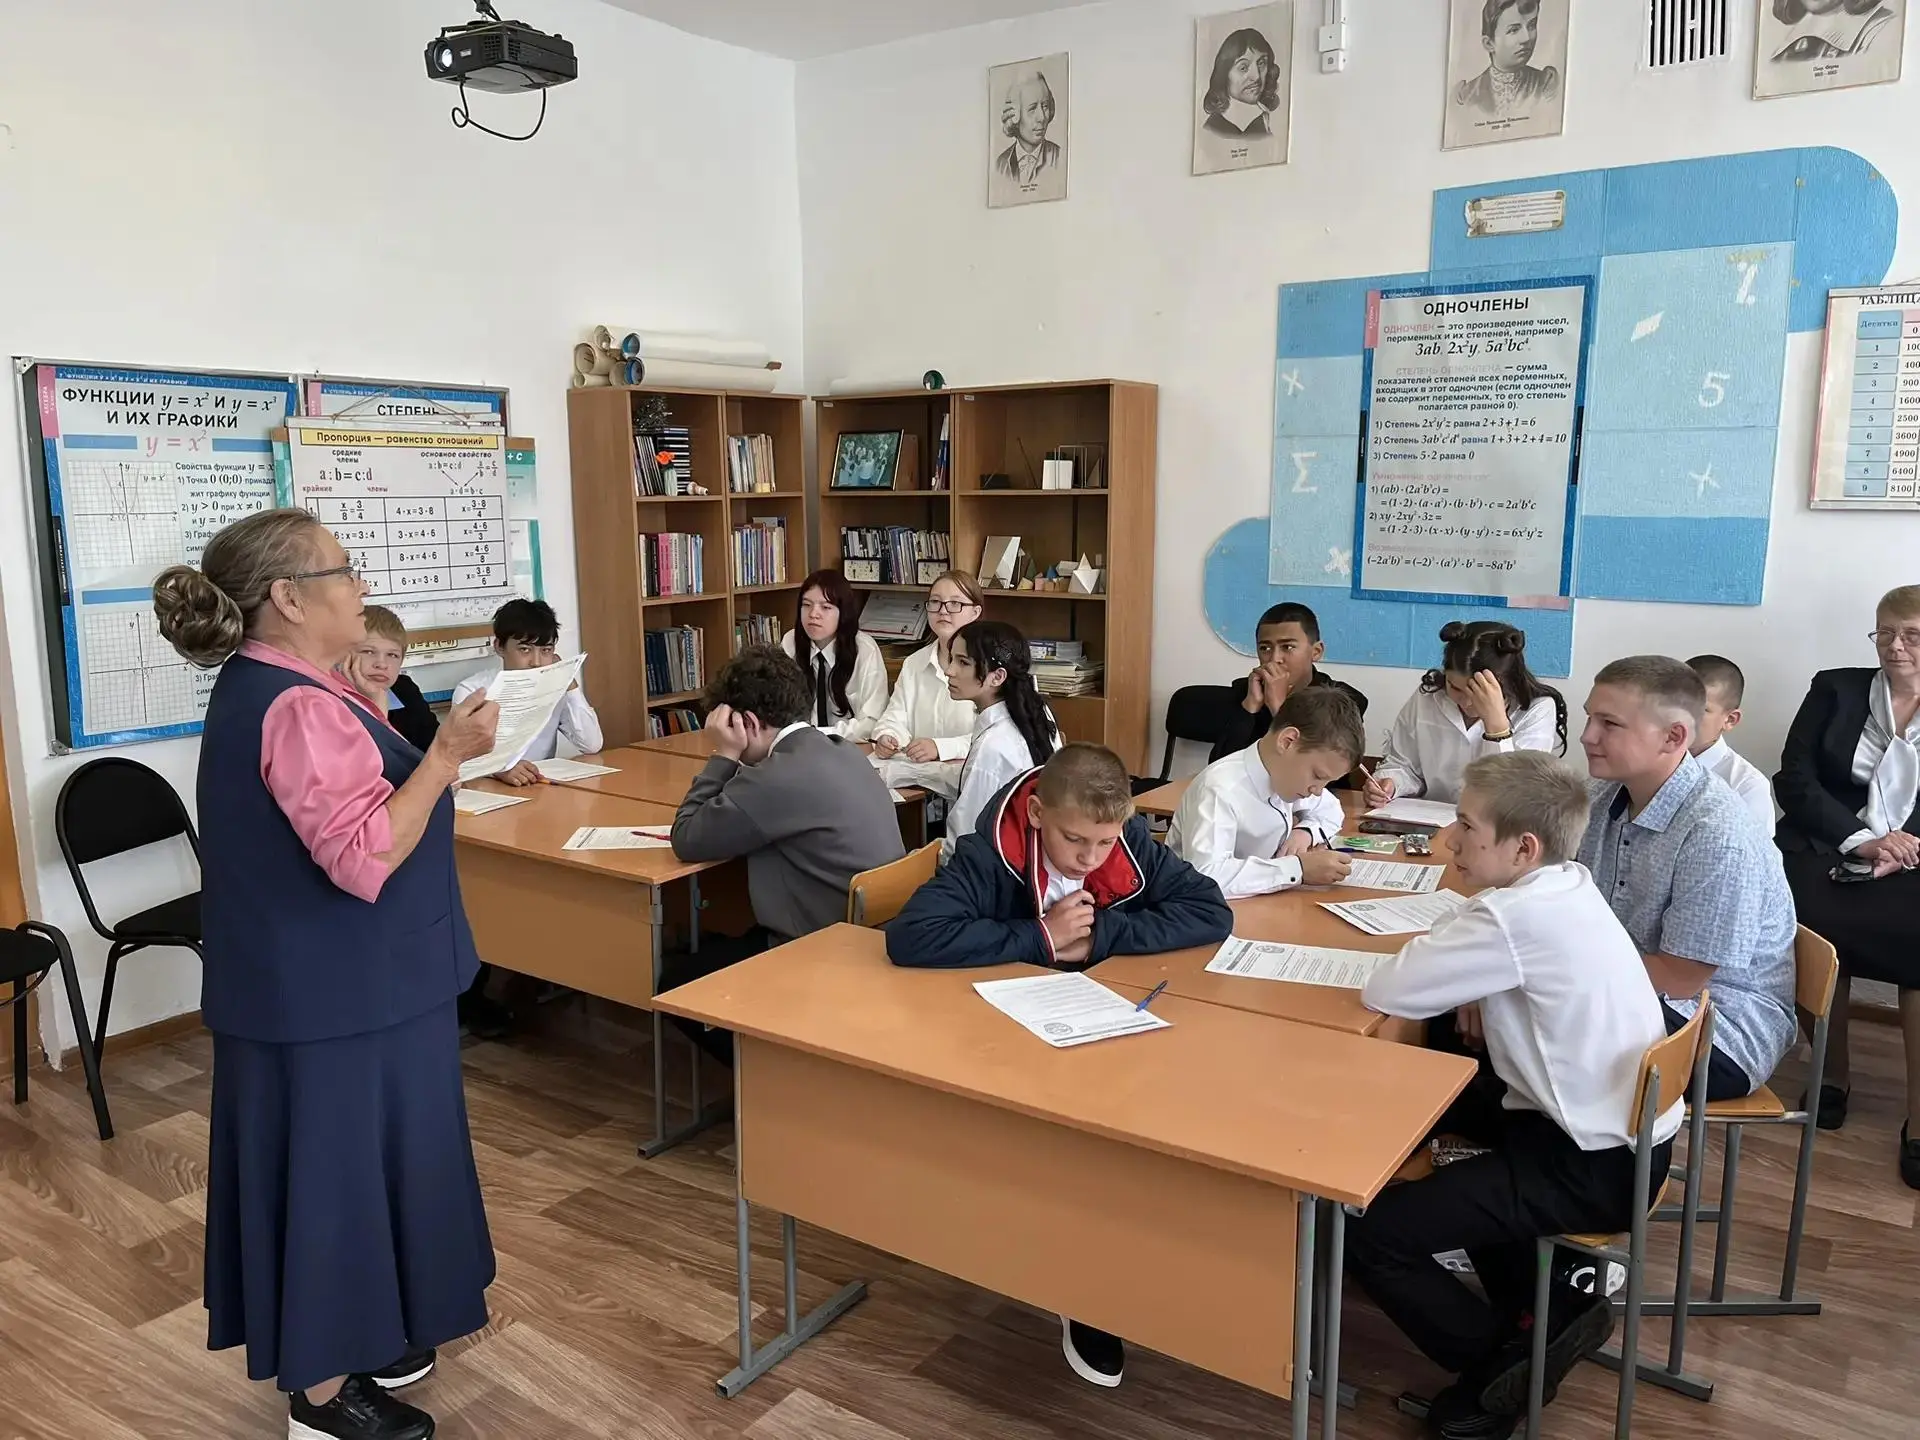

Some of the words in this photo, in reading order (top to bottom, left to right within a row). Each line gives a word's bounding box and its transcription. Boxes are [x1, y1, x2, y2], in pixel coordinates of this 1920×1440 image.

[1423, 296, 1529, 317] ОДНОЧЛЕНЫ
[1448, 322, 1464, 331] это
[1466, 319, 1534, 331] произведение
[1536, 317, 1569, 326] чисел,
[1860, 320, 1898, 329] Десятки
[1912, 326, 1918, 334] 0
[1386, 332, 1442, 343] переменных
[1466, 329, 1512, 339] степеней,
[1514, 327, 1564, 338] например
[1874, 344, 1879, 352] 1
[1516, 364, 1548, 373] сумма
[1904, 361, 1920, 369] 400
[1377, 376, 1432, 385] показателей
[1434, 374, 1476, 384] степеней
[1478, 374, 1500, 382] всех
[1502, 372, 1567, 382] переменных,
[1871, 379, 1877, 387] 3
[1902, 379, 1919, 387] 900
[1375, 386, 1418, 395] входящих
[1449, 384, 1493, 394] одночлен
[1495, 383, 1521, 392] (если
[1523, 382, 1571, 391] одночлен
[1698, 371, 1731, 408] 5
[62, 388, 155, 407] ФУНКЦИИ
[215, 396, 225, 409] И
[1388, 395, 1430, 404] содержит
[1432, 393, 1493, 403] переменных,
[1526, 392, 1567, 400] степень
[1870, 397, 1875, 405] 4
[1899, 397, 1920, 405] 1600
[377, 404, 441, 416] СТЕПЕНЬ
[1418, 403, 1468, 411] полагается
[1470, 401, 1505, 411] равной
[107, 411, 119, 424] И
[126, 411, 150, 425] ИХ
[157, 412, 238, 429] ГРАФИКИ
[1868, 414, 1874, 422] 5
[1897, 414, 1919, 422] 2500
[1375, 421, 1383, 430] 1)
[1384, 420, 1420, 429] Степень
[1453, 420, 1480, 429] равна
[317, 431, 372, 444] Пропорция
[386, 435, 434, 446] равенство
[436, 436, 484, 446] отношений
[1374, 436, 1382, 446] 2)
[1383, 435, 1419, 445] Степень
[1461, 435, 1488, 444] равна
[1866, 432, 1872, 440] 6
[1895, 432, 1917, 440] 3600
[332, 449, 362, 458] средние
[420, 451, 457, 459] основное
[458, 450, 492, 459] свойство
[1373, 452, 1381, 461] 3)
[1383, 451, 1418, 460] Степень
[1439, 453, 1466, 461] равна
[1468, 450, 1475, 460] 0
[1894, 449, 1916, 457] 4900
[175, 461, 212, 471] Свойства
[213, 463, 246, 473] функции
[1863, 467, 1869, 475] 8
[1892, 467, 1914, 475] 6400
[177, 476, 185, 485] 1)
[185, 476, 208, 485] Точка
[219, 473, 243, 486] (0;0)
[302, 484, 333, 494] крайние
[1371, 485, 1379, 495] 1)
[1890, 484, 1912, 492] 8100
[190, 490, 204, 498] жит
[206, 490, 238, 499] графику
[238, 490, 270, 499] функции
[181, 503, 189, 512] 2)
[221, 504, 235, 512] при
[356, 500, 362, 509] 3
[342, 512, 348, 521] 8
[357, 512, 363, 520] 4
[1369, 511, 1377, 521] 2)
[184, 530, 192, 540] 3)
